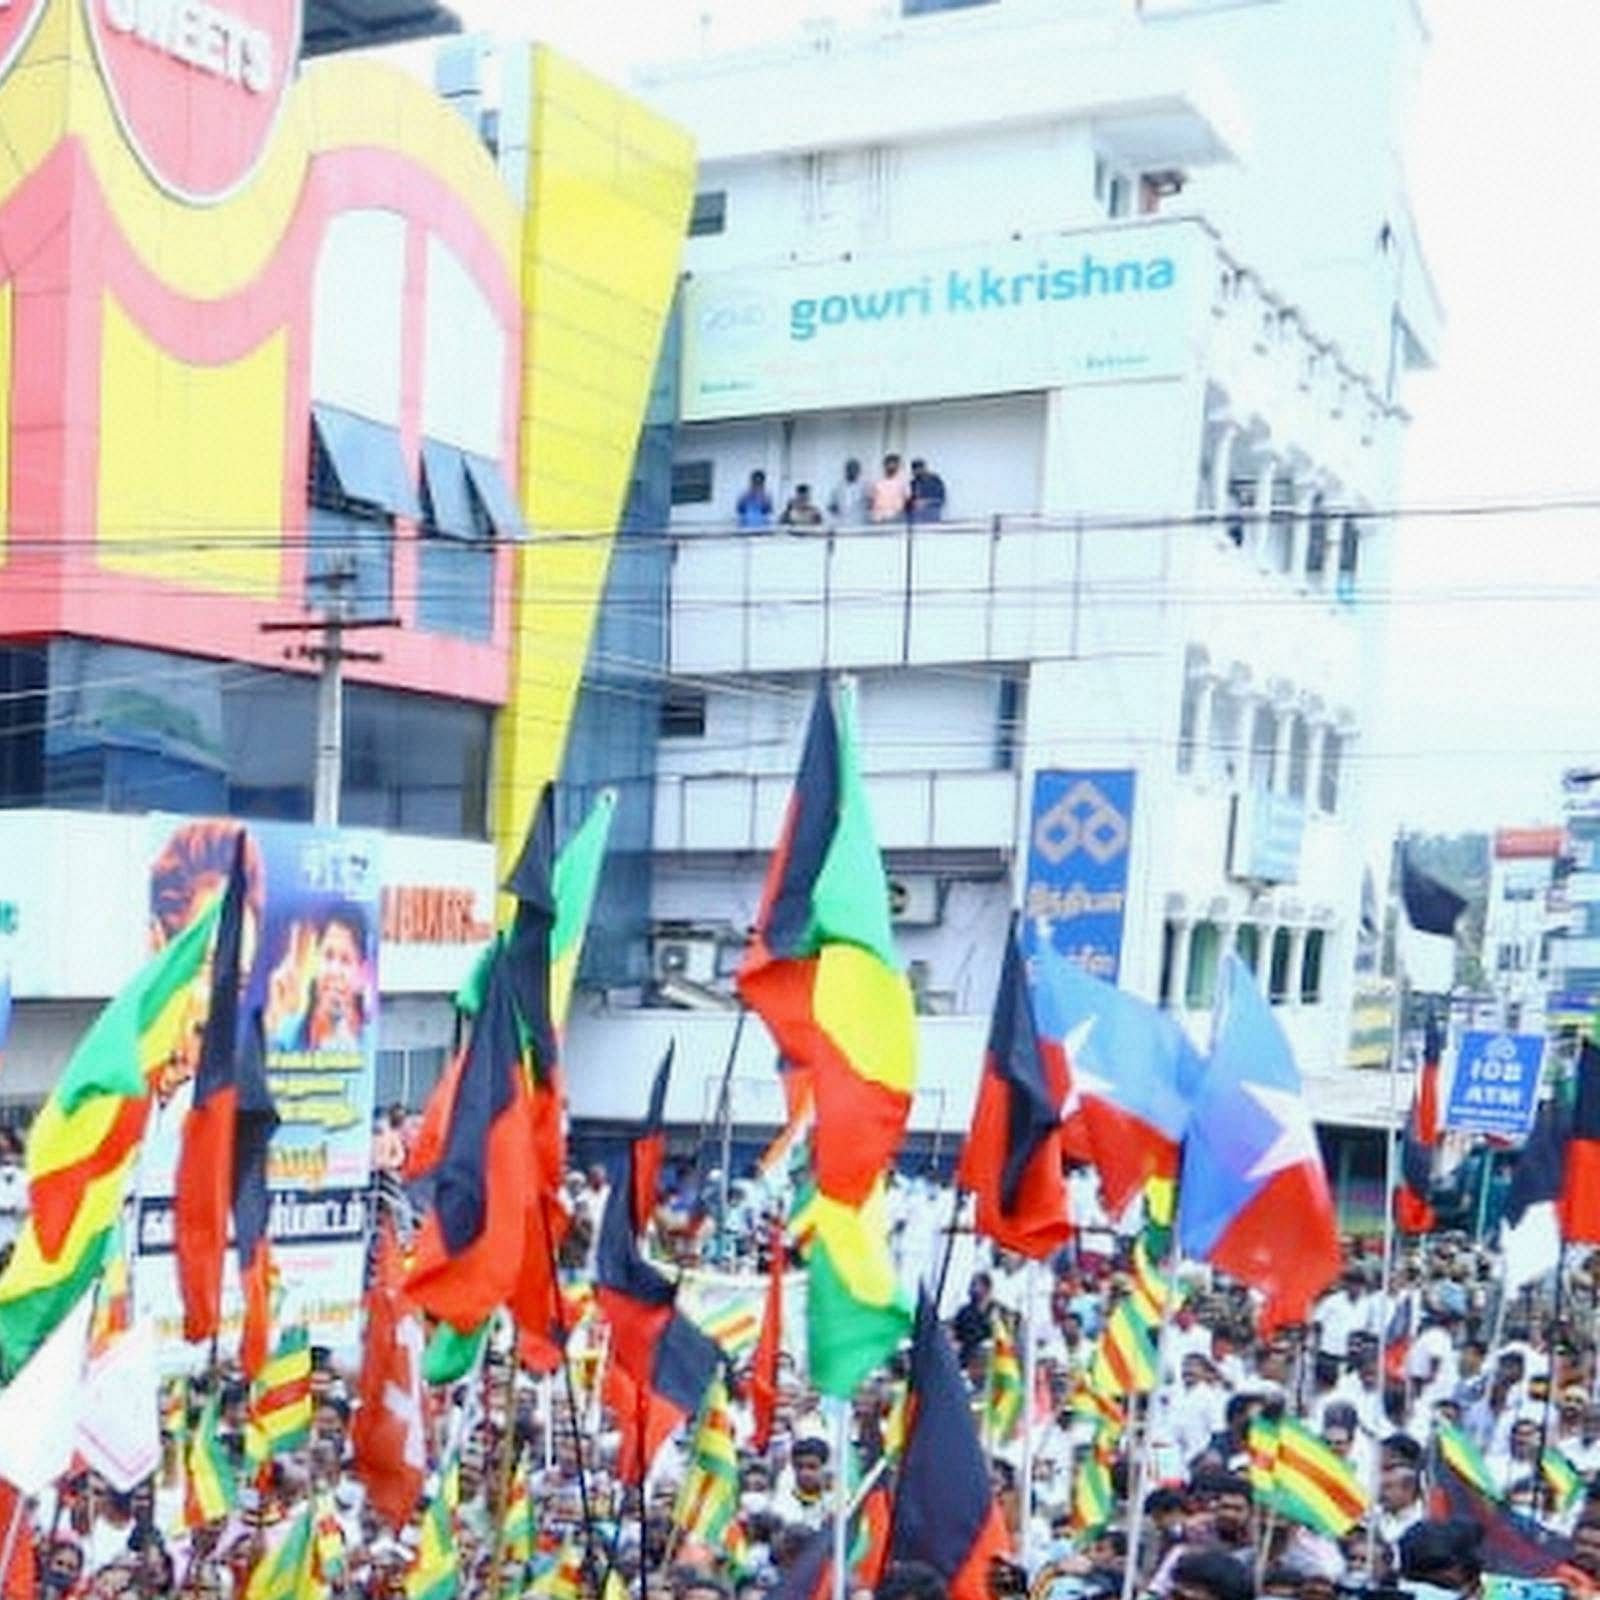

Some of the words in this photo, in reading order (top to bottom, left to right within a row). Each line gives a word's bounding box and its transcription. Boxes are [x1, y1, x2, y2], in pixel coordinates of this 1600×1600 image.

[790, 277, 930, 340] gowri
[947, 254, 1176, 314] kkrishna
[1471, 1059, 1522, 1082] IOB
[1464, 1086, 1523, 1106] ATM
